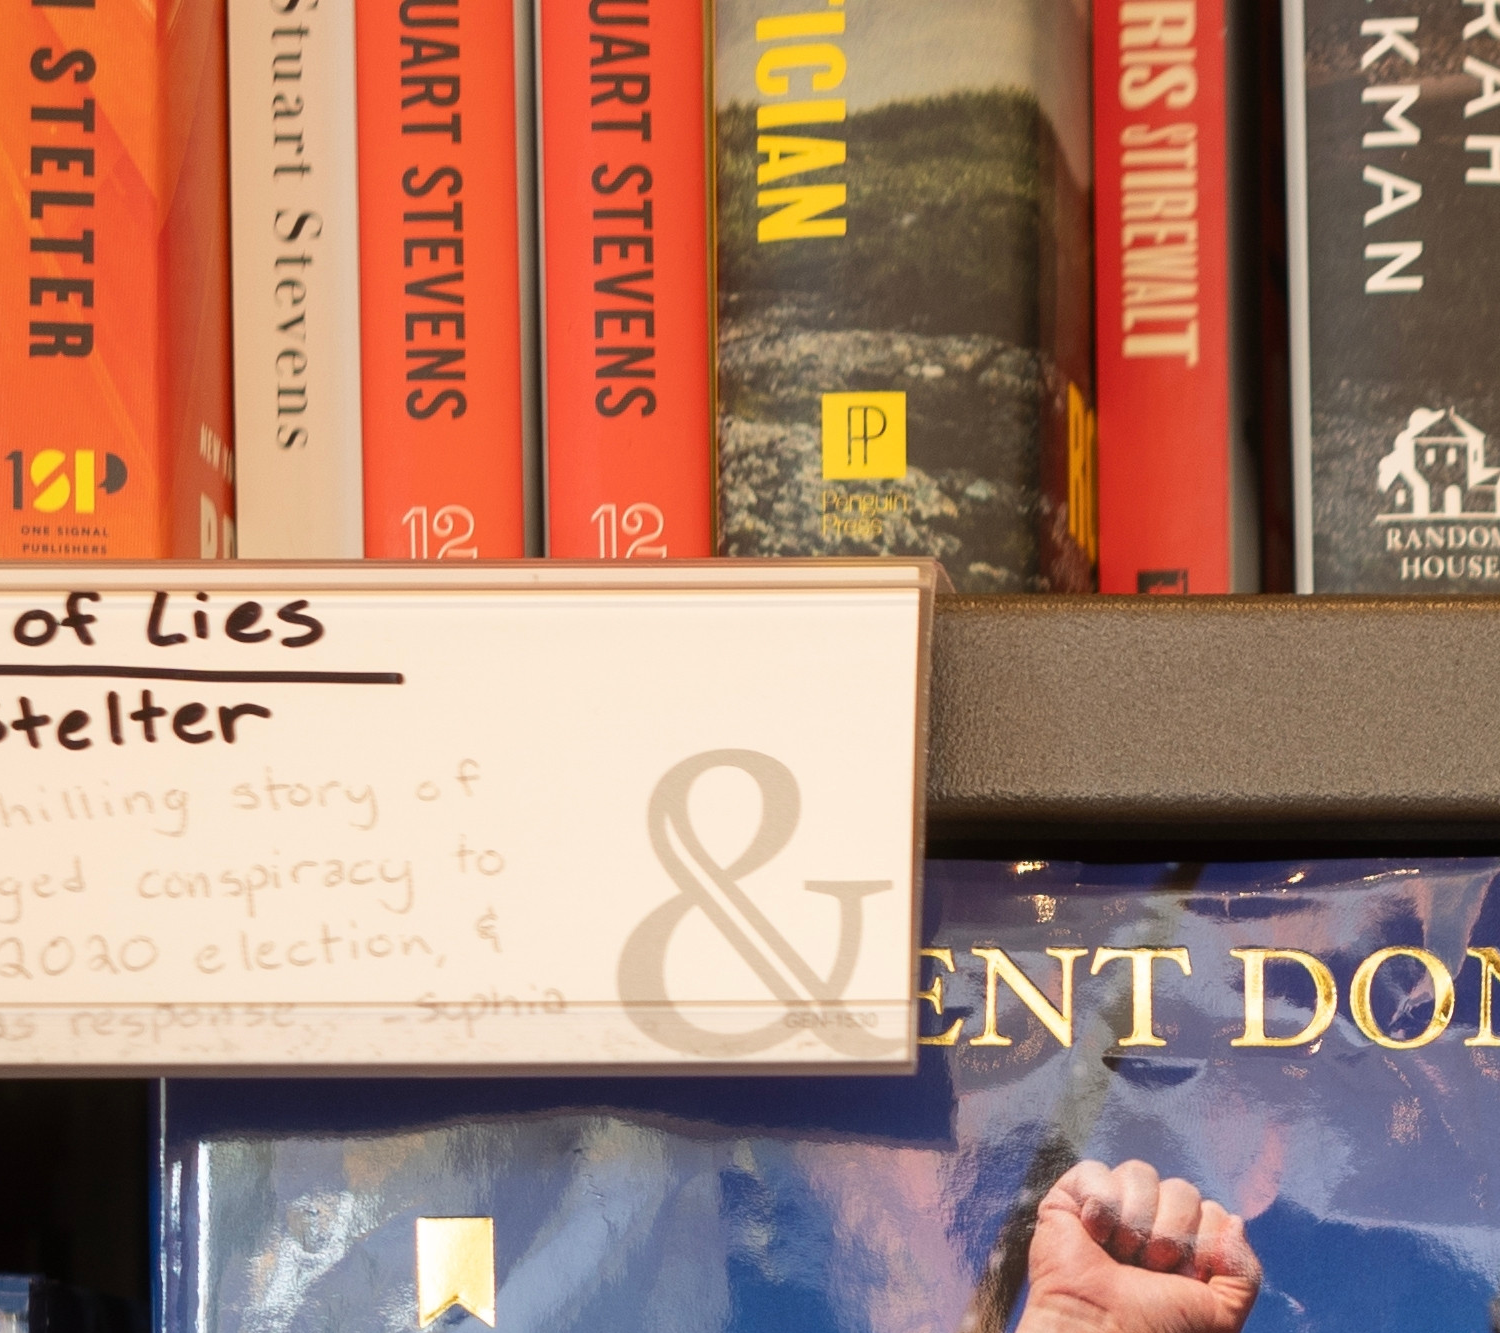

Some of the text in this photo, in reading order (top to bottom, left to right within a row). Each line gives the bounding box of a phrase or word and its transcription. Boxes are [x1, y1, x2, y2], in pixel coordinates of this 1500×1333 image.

[28, 47, 97, 361] STELTER
[1119, 122, 1200, 369] STIREWALT
[274, 207, 323, 452] Stevens
[401, 165, 468, 422] STEVENS
[591, 163, 657, 420] STEVENS
[21, 526, 109, 538] ONE SIGNAL
[22, 544, 108, 555] PUBLISHERS
[1400, 555, 1500, 580] HOUSE
[12, 591, 100, 648] of
[146, 591, 325, 649] Lies
[232, 767, 380, 831] story
[415, 757, 481, 803] of
[136, 850, 416, 916] conspiracy
[455, 836, 507, 877] to
